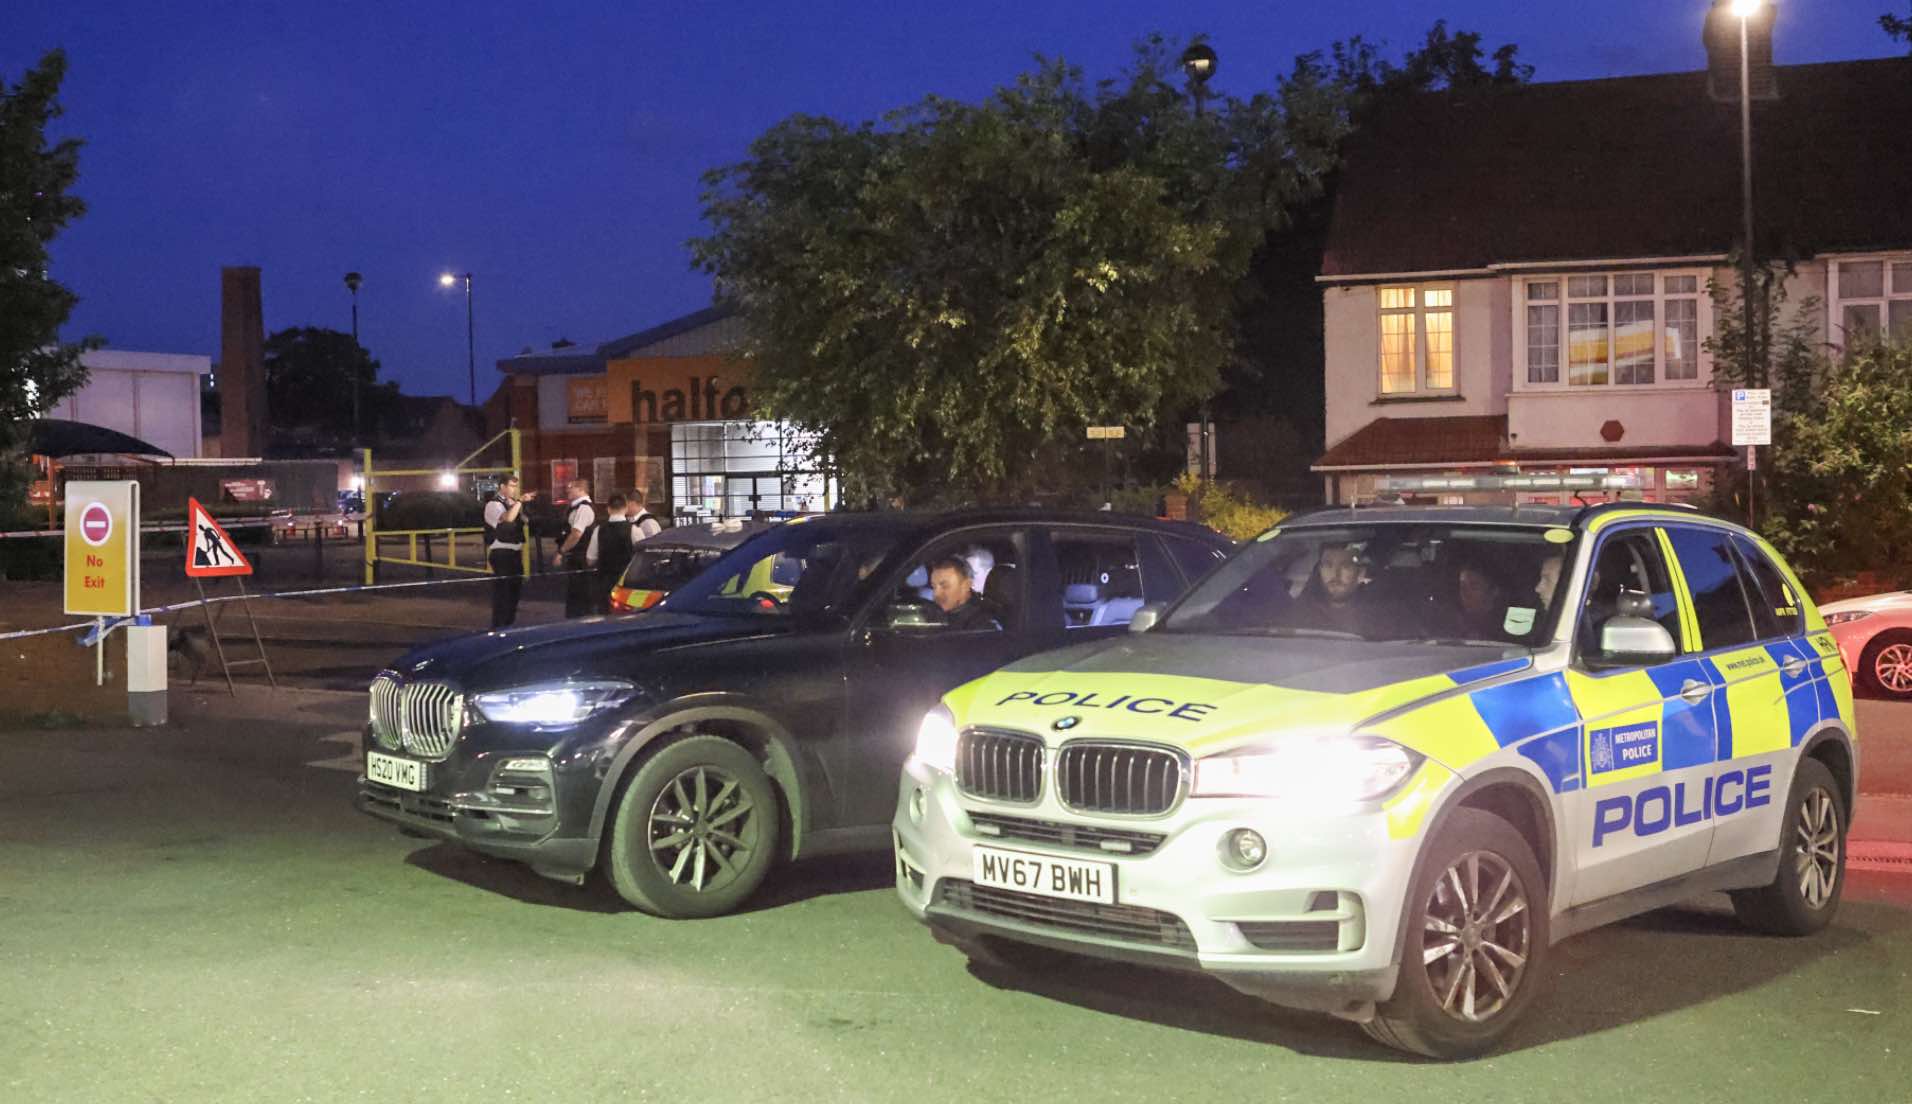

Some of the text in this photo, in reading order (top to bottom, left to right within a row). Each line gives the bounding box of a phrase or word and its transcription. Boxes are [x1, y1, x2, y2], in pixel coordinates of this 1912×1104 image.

[631, 375, 750, 422] halfo
[86, 554, 104, 568] No
[84, 575, 105, 589] Exit
[995, 691, 1218, 722] POLICE
[1615, 728, 1656, 744] METROPOLITAN
[1622, 744, 1652, 760] POLICE
[371, 758, 415, 785] HS20 VMG
[1592, 764, 1772, 848] POLICE
[982, 853, 1101, 897] MV67 BWH
